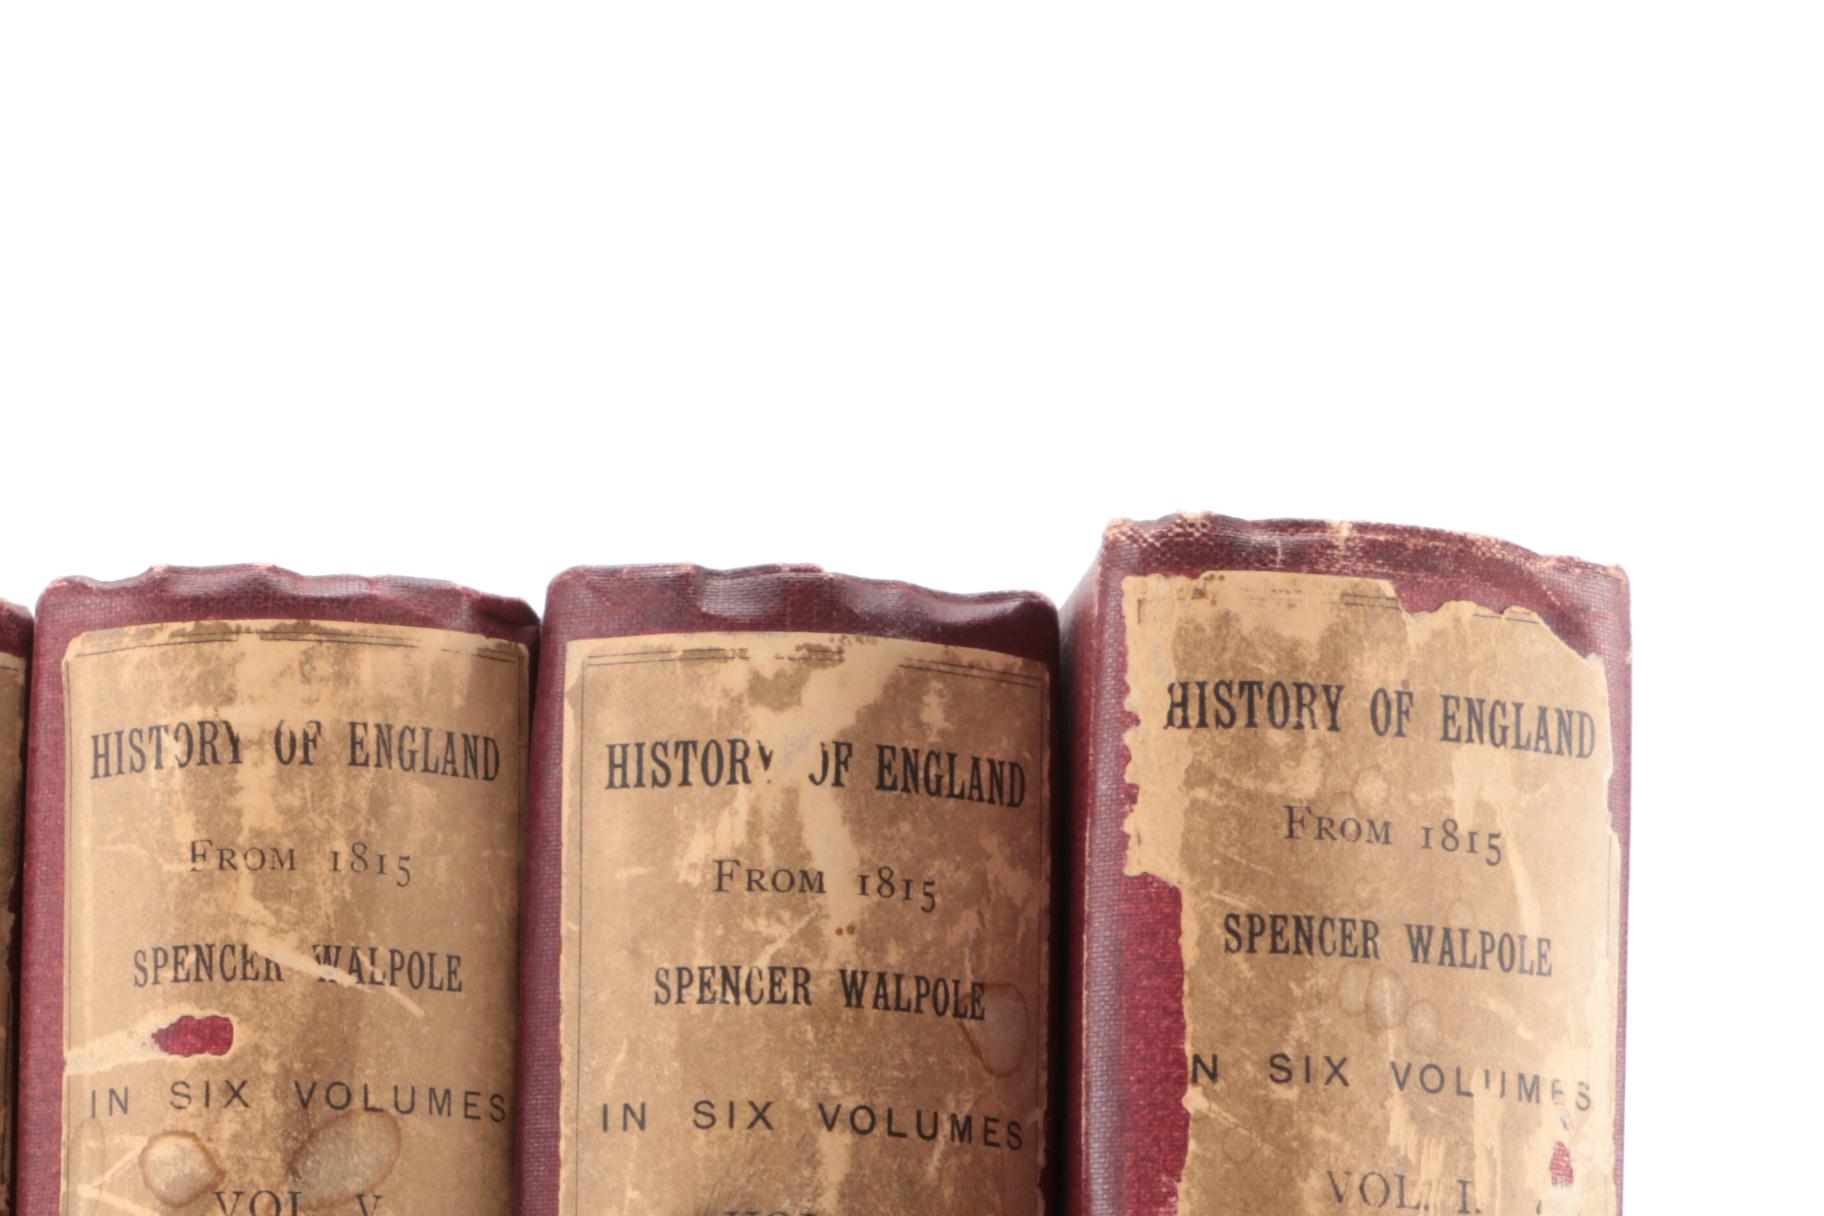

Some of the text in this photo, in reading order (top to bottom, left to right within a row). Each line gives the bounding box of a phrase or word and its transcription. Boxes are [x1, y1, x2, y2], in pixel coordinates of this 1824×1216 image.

[1163, 680, 1596, 759] HISTORY OF ENGLAND
[91, 719, 500, 782] HISTORY OF ENGLAND
[875, 743, 1025, 808] ENGLAND
[330, 842, 412, 887] 1815
[1421, 819, 1503, 866] 1815
[858, 866, 937, 913] 1815
[1224, 913, 1553, 978] SPENCER WALPOLE
[655, 966, 985, 1021] SPENCER WALPOLE
[1269, 1054, 1351, 1087] SIX
[91, 1079, 507, 1123] IN SIX VOLUMES
[603, 1100, 1023, 1150] IN SIX VOLUMES
[1326, 1170, 1482, 1213] VOL. I.
